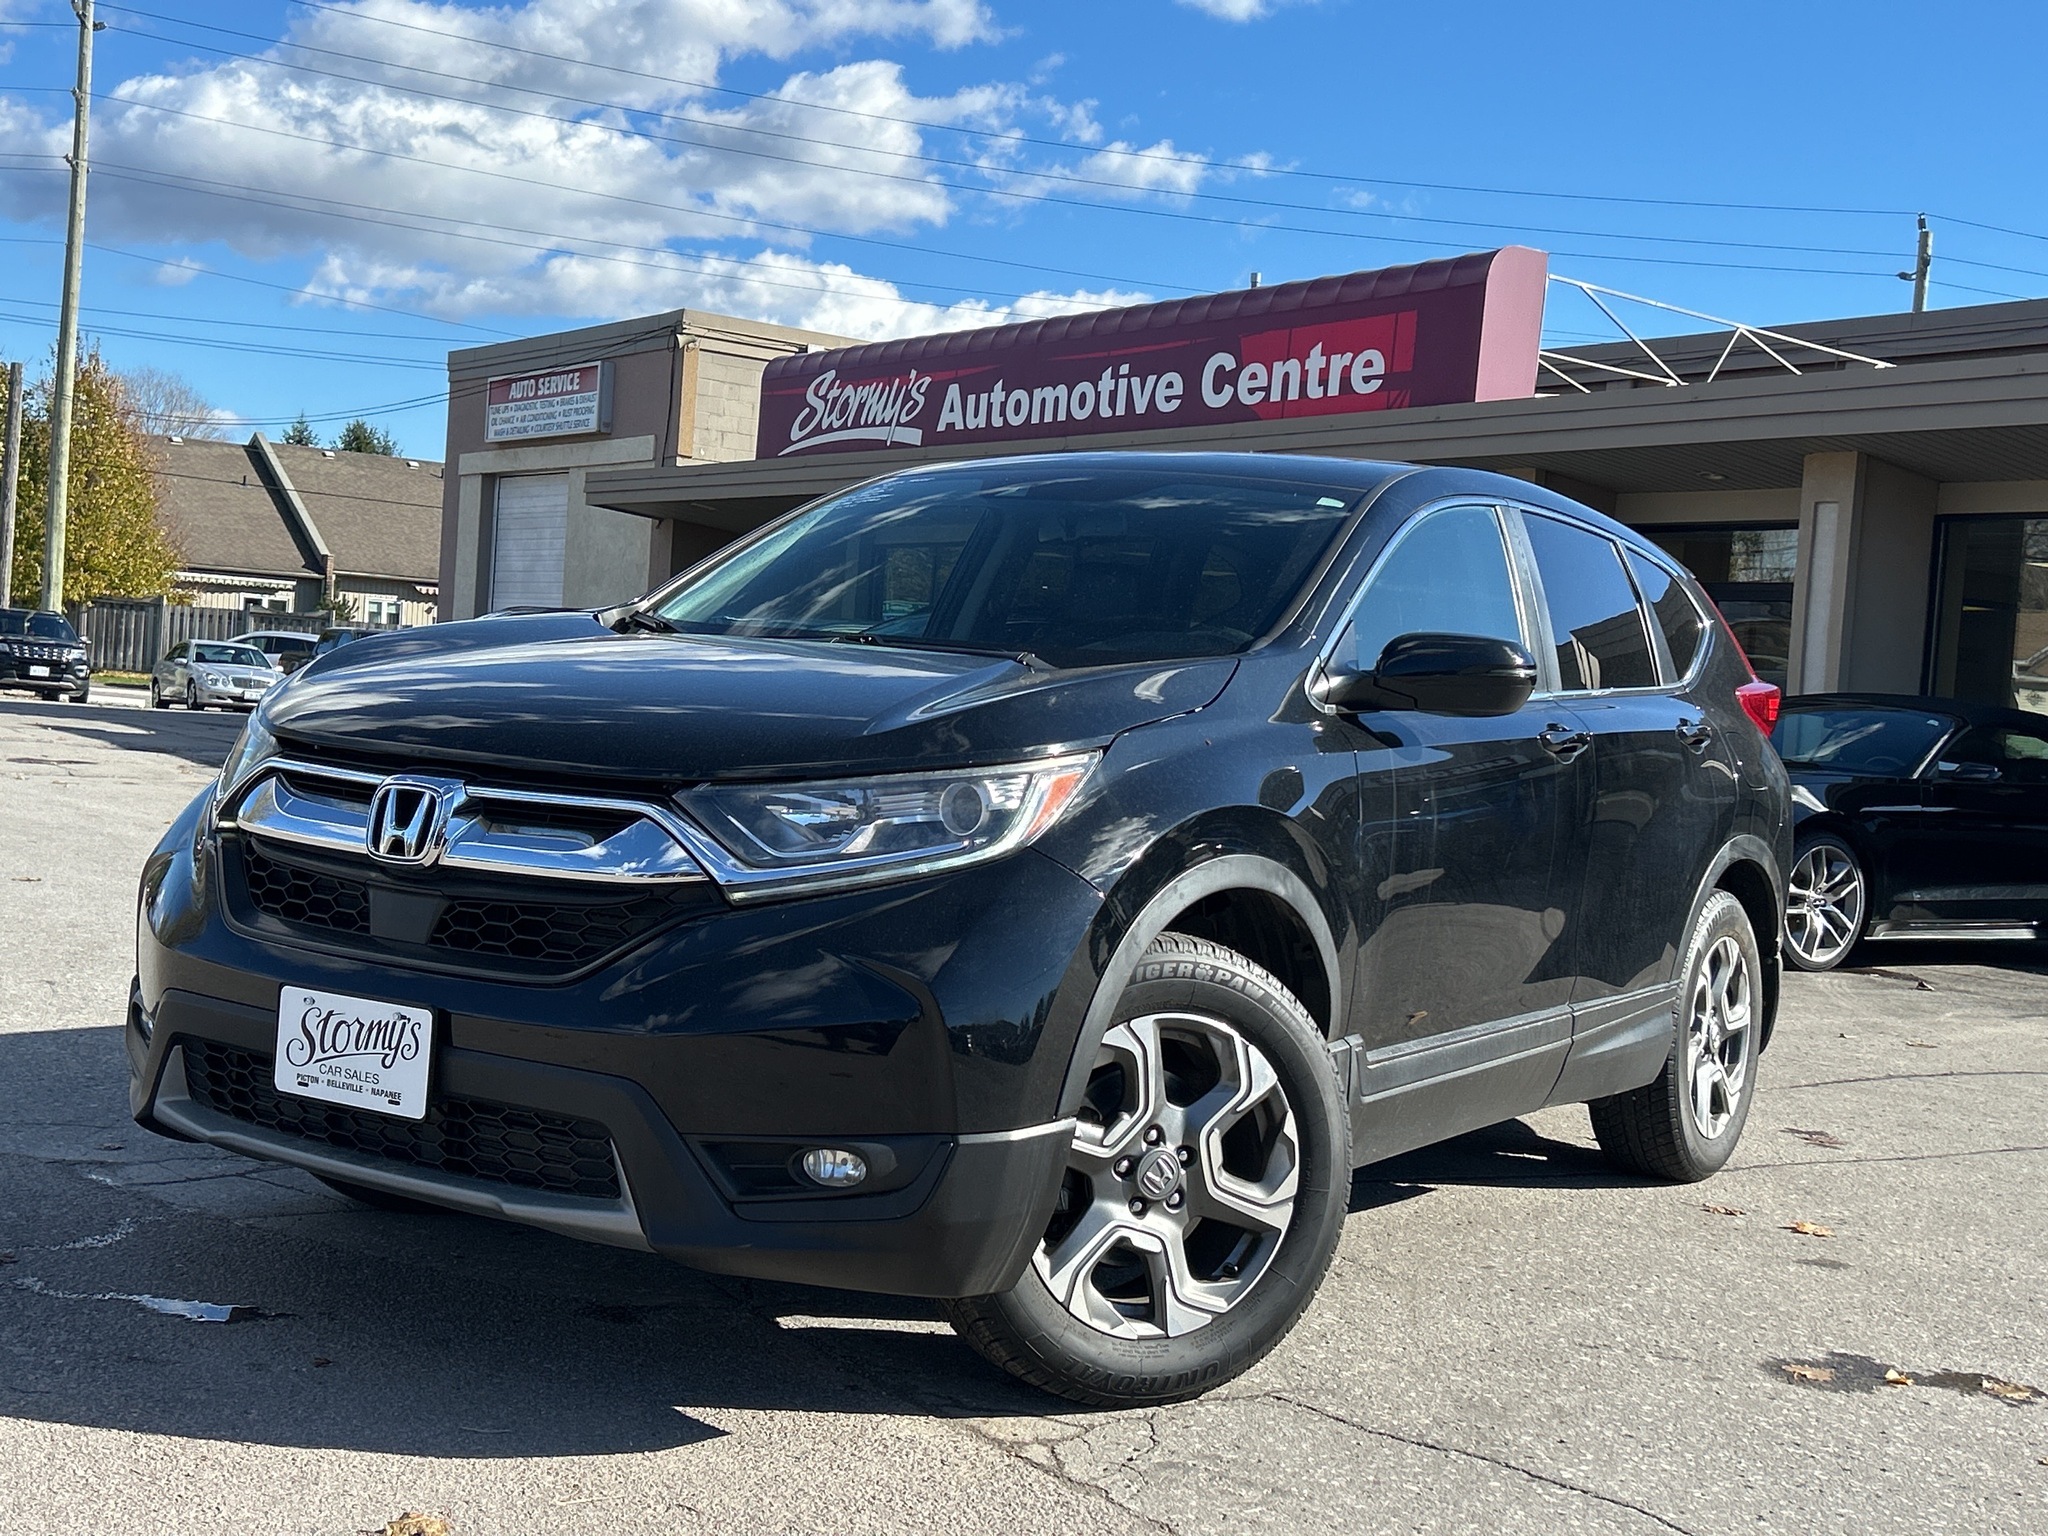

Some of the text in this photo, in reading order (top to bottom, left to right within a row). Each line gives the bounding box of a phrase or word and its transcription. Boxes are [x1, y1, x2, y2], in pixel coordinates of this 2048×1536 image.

[509, 372, 580, 400] AUTO SERVICE
[790, 341, 1386, 446] Stormy's Automotive Centre
[1135, 962, 1193, 983] IGER
[1213, 970, 1265, 999] PAW
[286, 1007, 421, 1069] Stormy's
[296, 1072, 402, 1101] PICTON BELLEVILLE NAPANEE
[319, 1064, 380, 1085] CAR SALES
